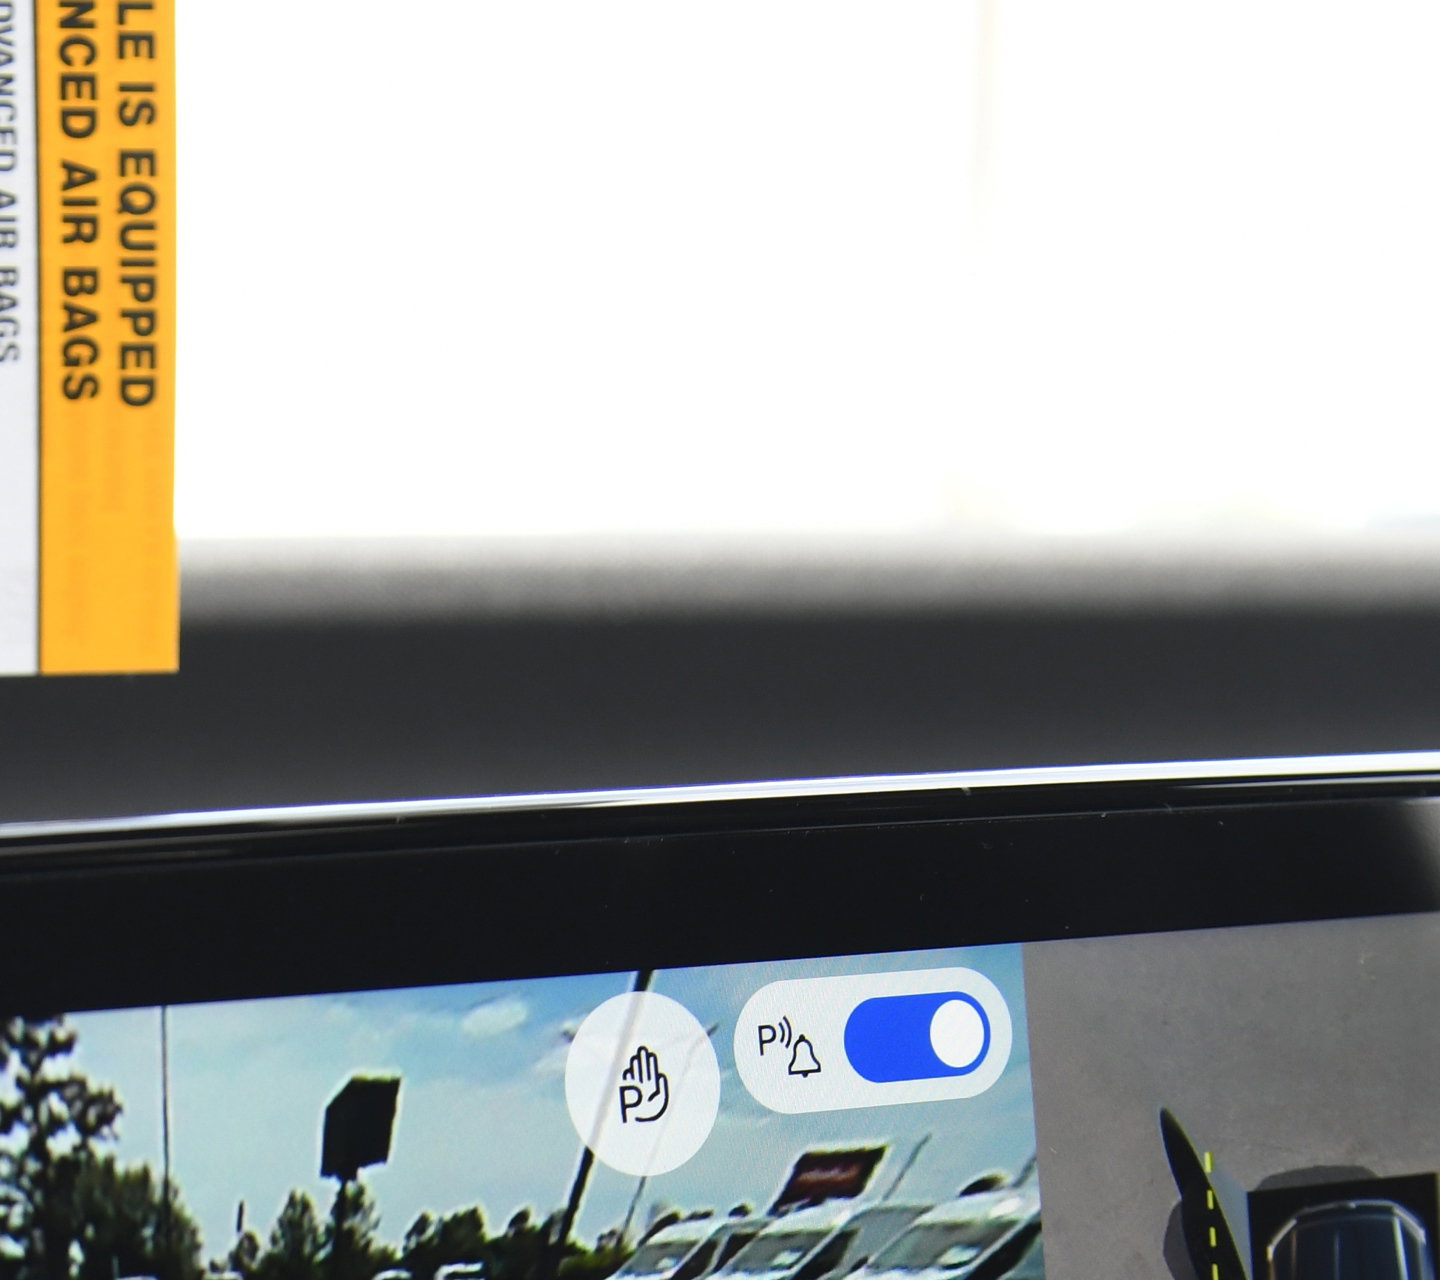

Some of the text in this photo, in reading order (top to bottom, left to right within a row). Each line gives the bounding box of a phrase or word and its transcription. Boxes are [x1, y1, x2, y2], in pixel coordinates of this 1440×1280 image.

[58, 0, 99, 401] NCED AIR BAGS
[118, 0, 157, 407] LE IS EQUIPPED
